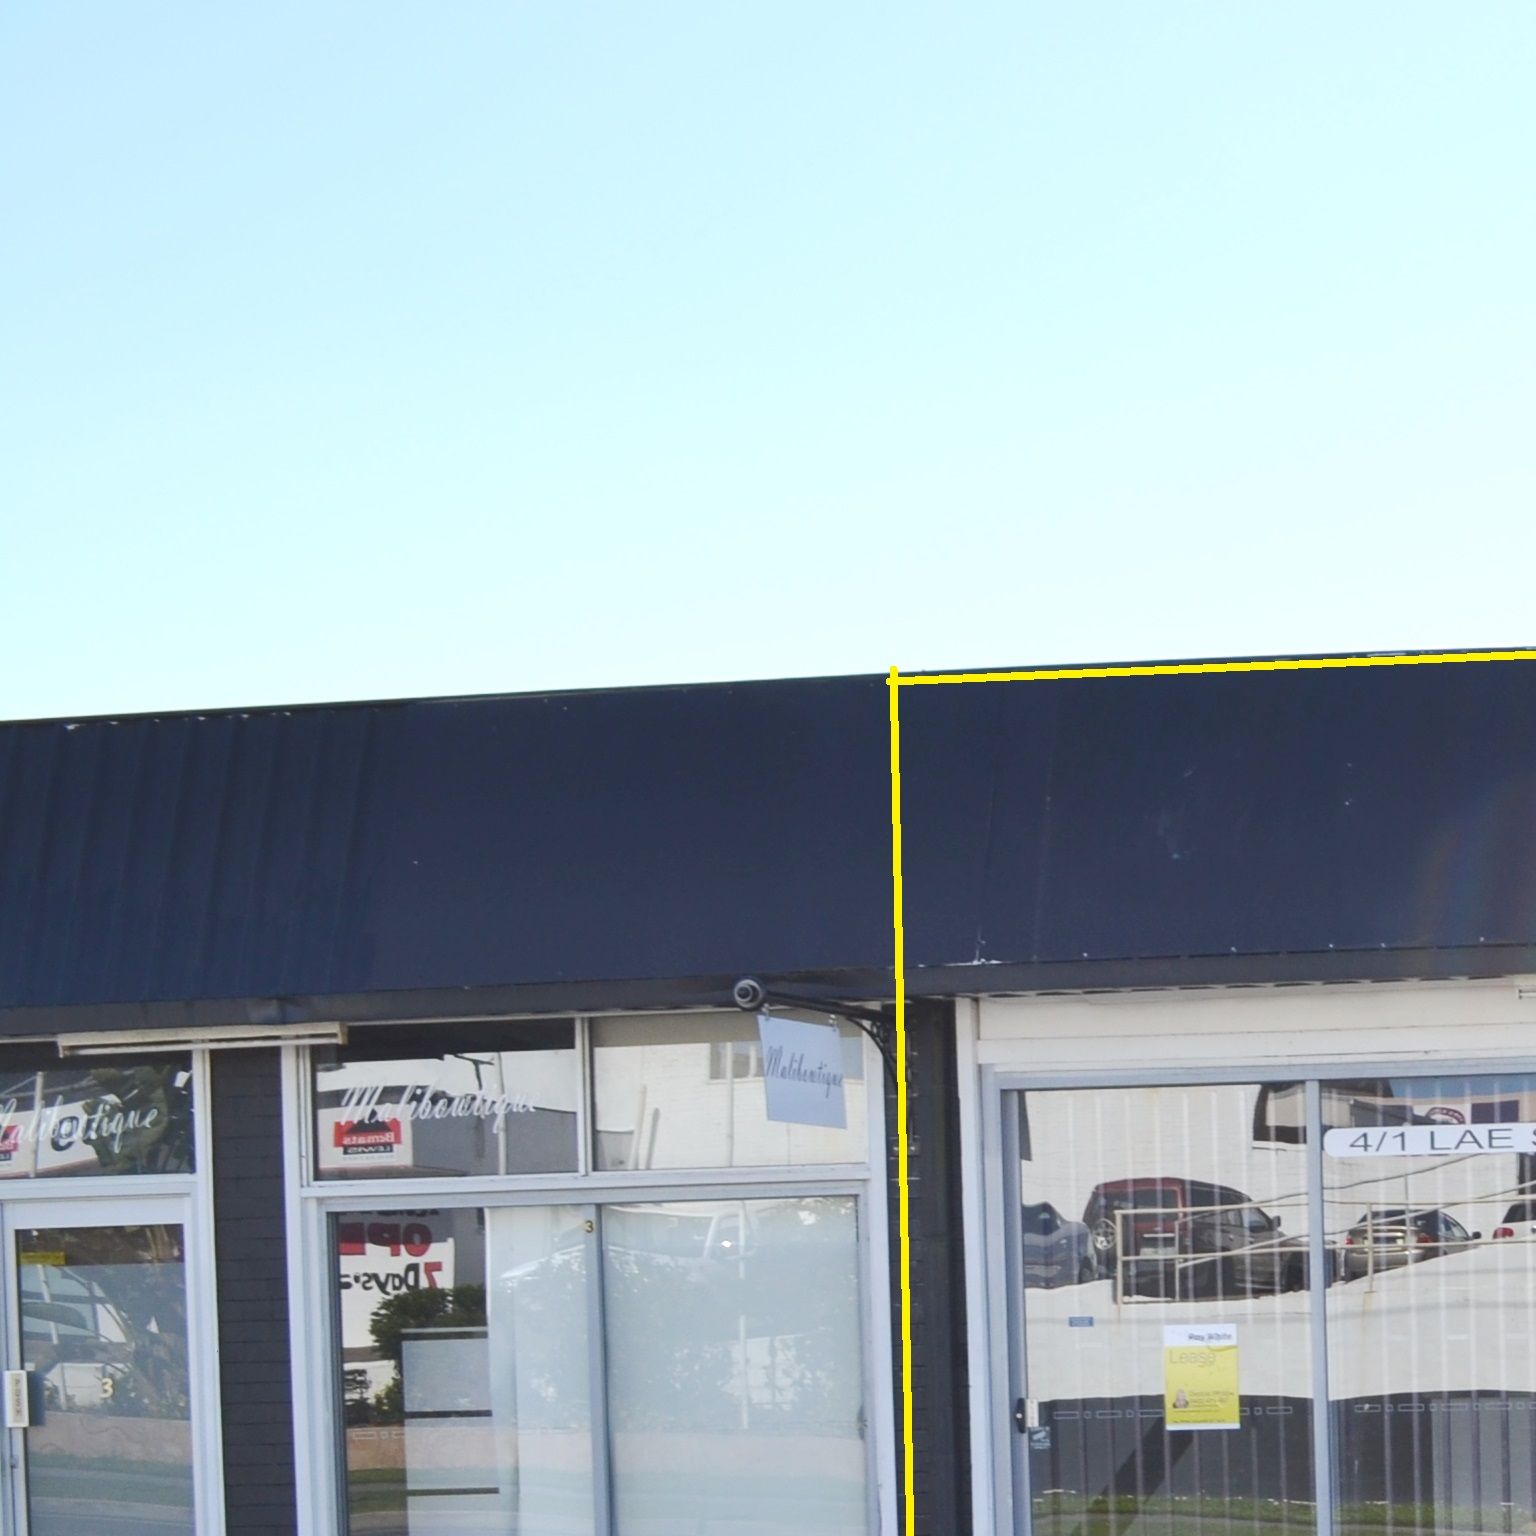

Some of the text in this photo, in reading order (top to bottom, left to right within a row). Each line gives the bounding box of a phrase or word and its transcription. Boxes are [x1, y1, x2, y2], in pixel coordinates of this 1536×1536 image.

[1350, 1131, 1407, 1152] 4/1
[1430, 1128, 1514, 1151] LAE
[585, 1220, 594, 1233] 3
[100, 1378, 114, 1398] 3
